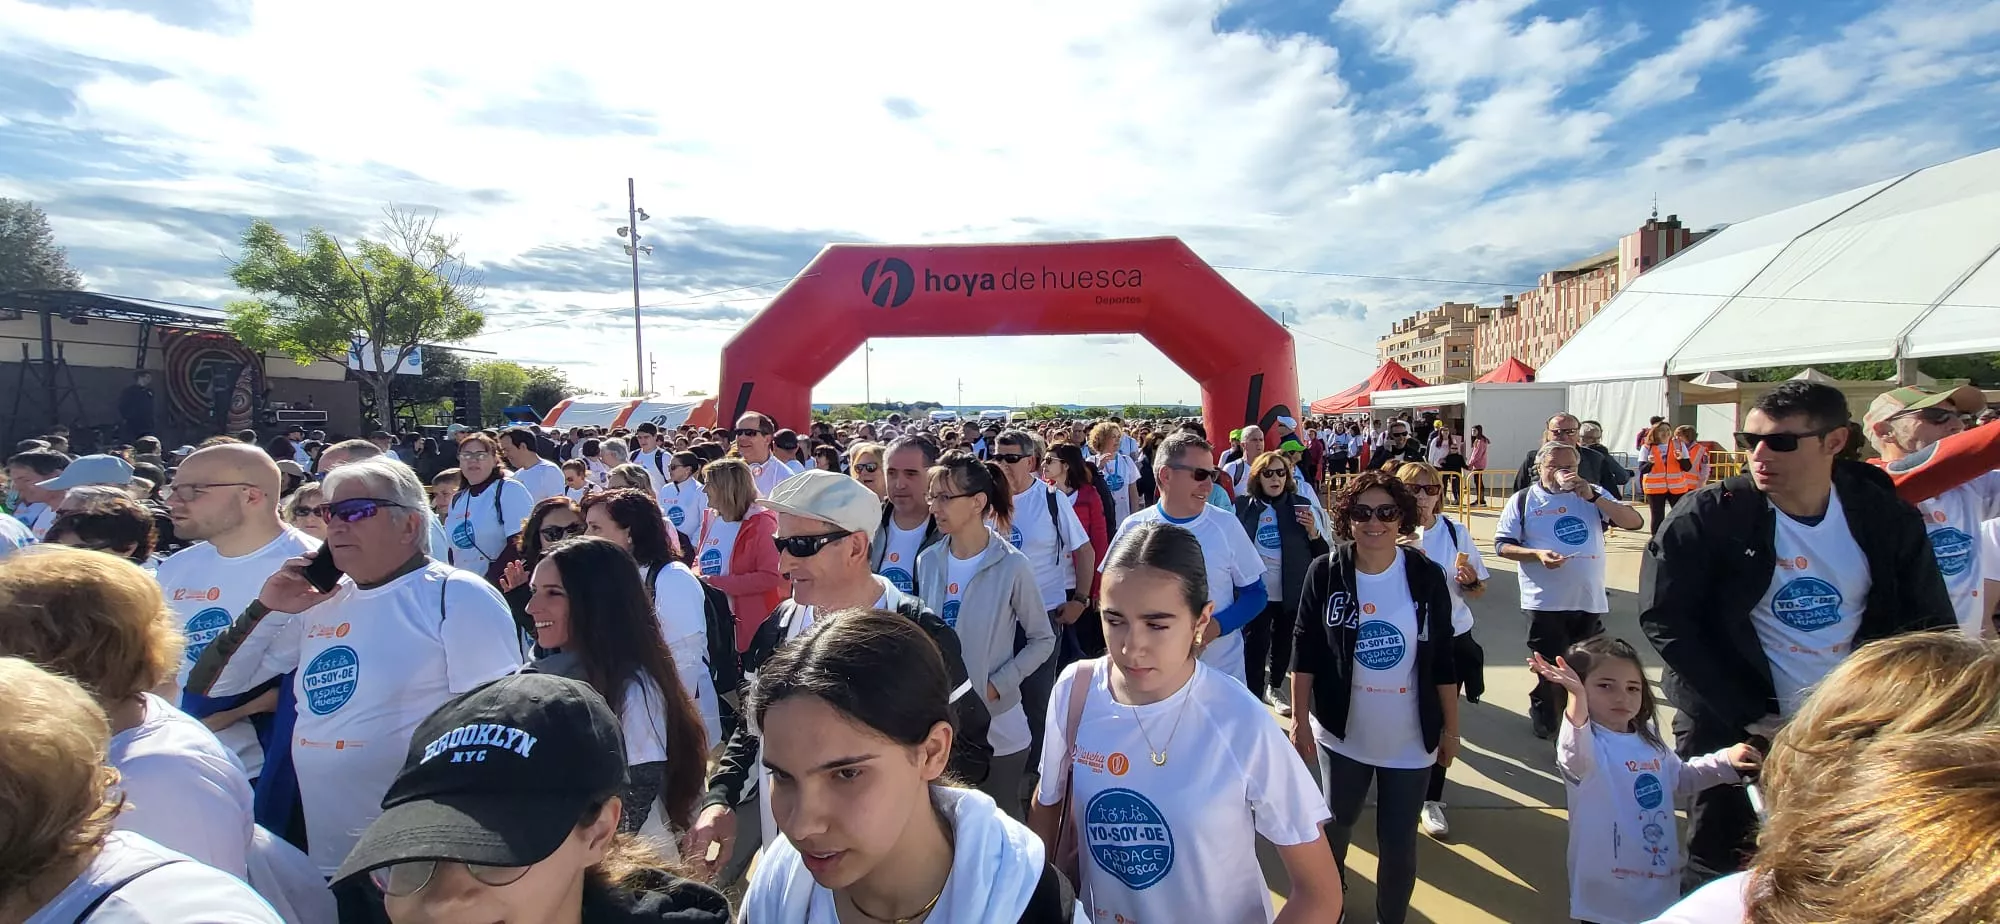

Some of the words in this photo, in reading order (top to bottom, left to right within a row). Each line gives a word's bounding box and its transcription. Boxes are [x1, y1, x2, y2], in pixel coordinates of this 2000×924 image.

[925, 268, 996, 297] hoya
[1001, 266, 1035, 291] de
[1042, 265, 1142, 291] huesca
[1095, 294, 1142, 306] Deportes
[419, 723, 538, 765] BROOKLYN
[449, 750, 487, 763] NYC
[1625, 760, 1638, 772] 12
